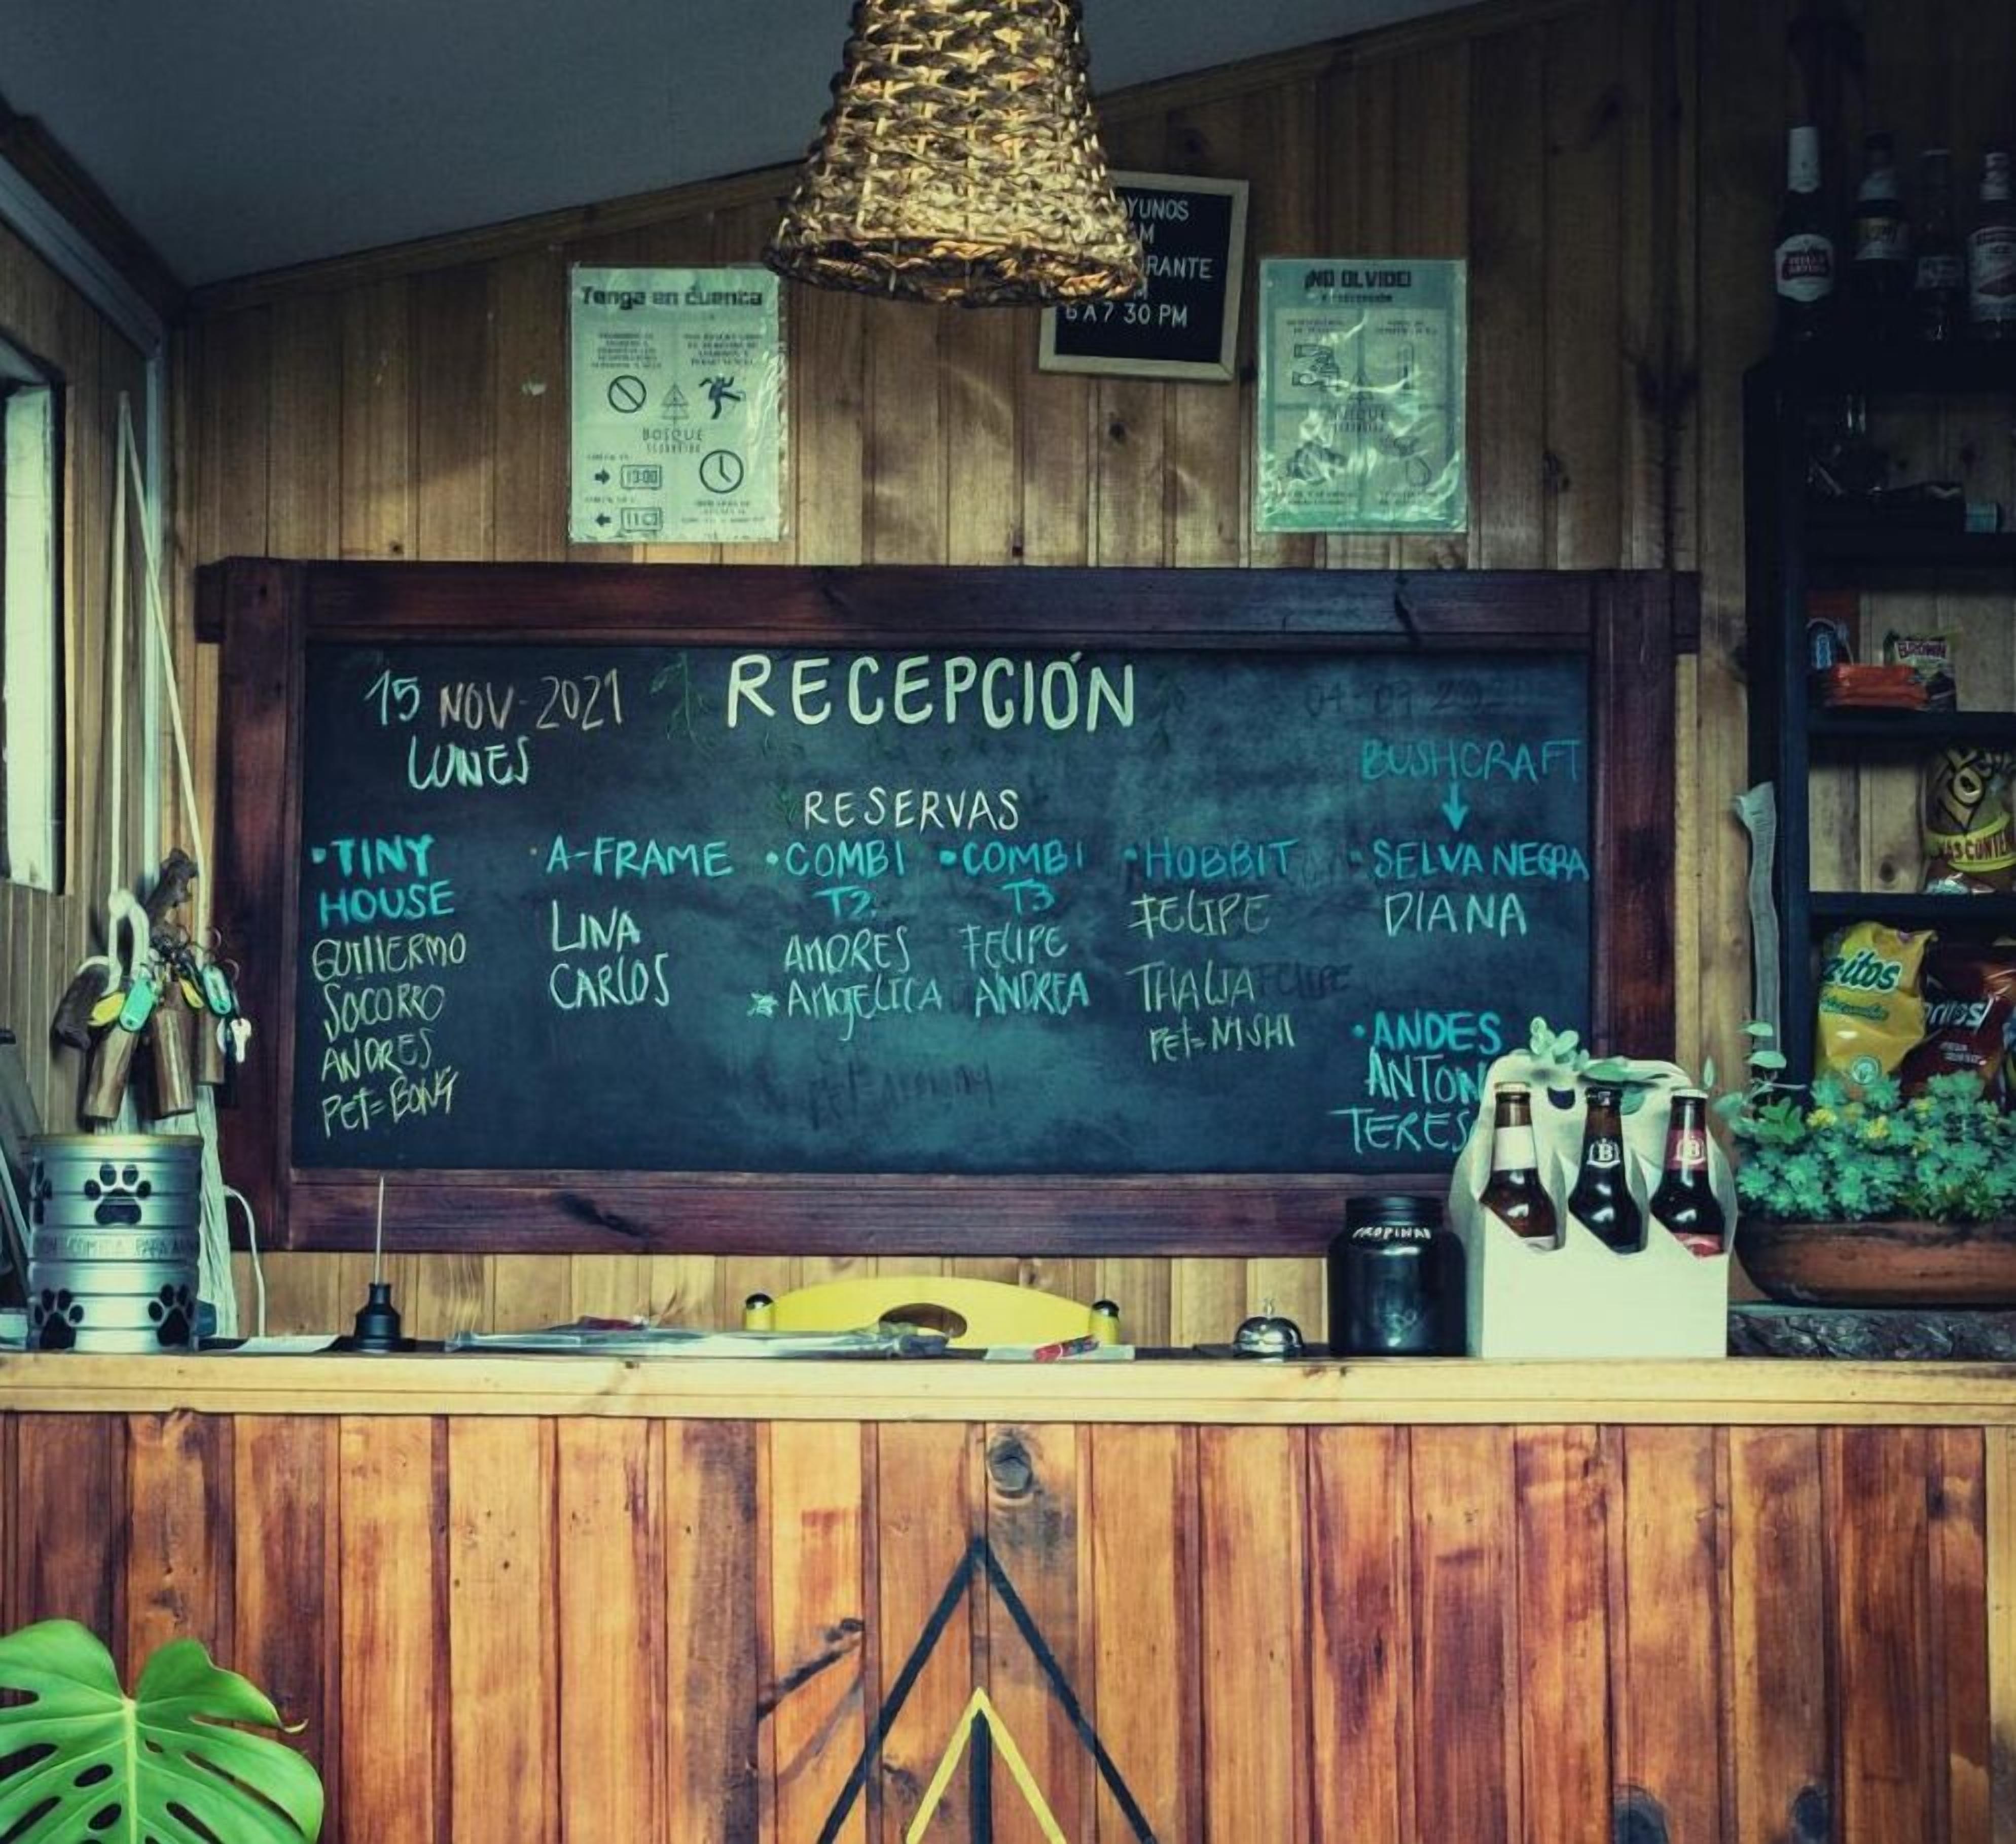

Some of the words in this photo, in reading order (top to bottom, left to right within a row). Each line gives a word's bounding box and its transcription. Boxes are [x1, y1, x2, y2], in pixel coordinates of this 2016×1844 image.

[1143, 255, 1213, 280] RANTE
[653, 292, 678, 305] en
[1159, 304, 1188, 330] PM
[363, 668, 422, 727] 15
[728, 650, 1134, 733] RECEPCIÓN
[408, 735, 530, 791] LUNES
[1361, 738, 1581, 785] BUSHCRAFT
[804, 786, 1020, 833] RESERVAS
[330, 833, 435, 880] TINY
[546, 834, 734, 880] A-FRAME
[785, 839, 905, 878] COMBI
[964, 840, 1083, 876] COMBI
[1145, 835, 1300, 879] HOBBIT
[1373, 837, 1484, 880] SELVA
[319, 879, 455, 929] HOUSE
[1384, 891, 1527, 939] DIANA
[322, 982, 446, 1043] SOCORRO
[1373, 1009, 1502, 1056] ANDES
